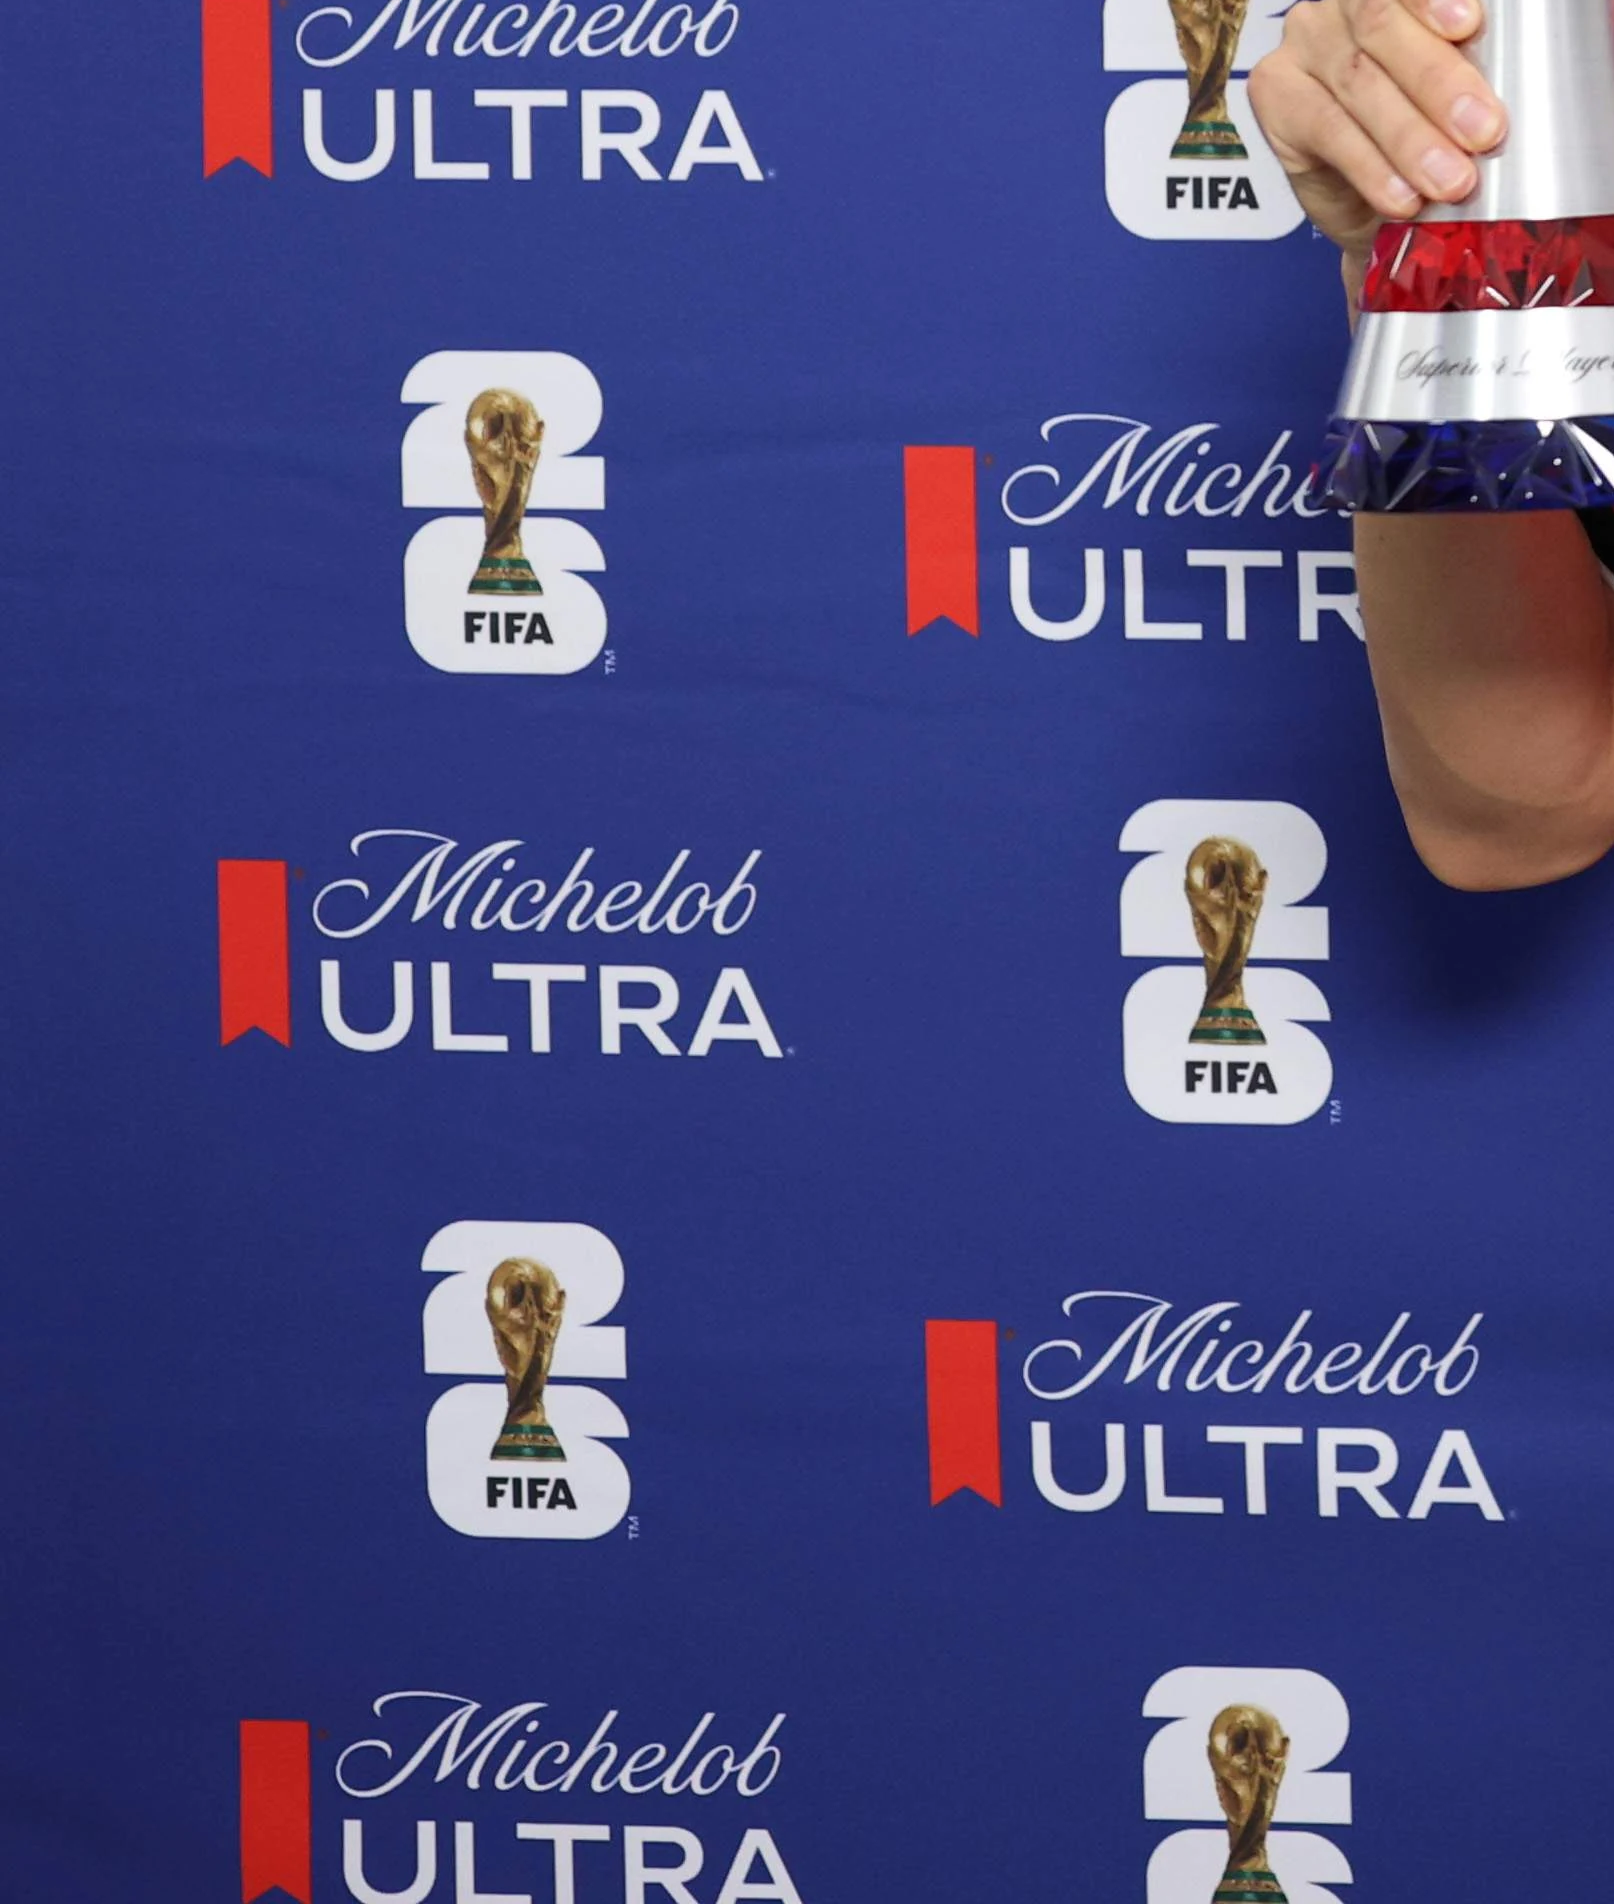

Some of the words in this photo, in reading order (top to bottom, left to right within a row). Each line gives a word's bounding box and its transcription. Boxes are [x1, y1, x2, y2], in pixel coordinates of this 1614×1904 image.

[301, 87, 765, 183] ULTRA
[1165, 176, 1260, 210] FIFA
[464, 611, 554, 645] FIFA
[1008, 545, 1366, 642] ULTR
[312, 828, 763, 940] Michelob
[319, 958, 785, 1059] ULTRA
[1184, 1060, 1278, 1095] FIFA
[1022, 1289, 1485, 1401] Michelob
[486, 1476, 578, 1510] FIFA
[1030, 1420, 1506, 1522] ULTRA
[335, 1690, 787, 1799] Michelob
[342, 1818, 804, 1904] ULTRA
